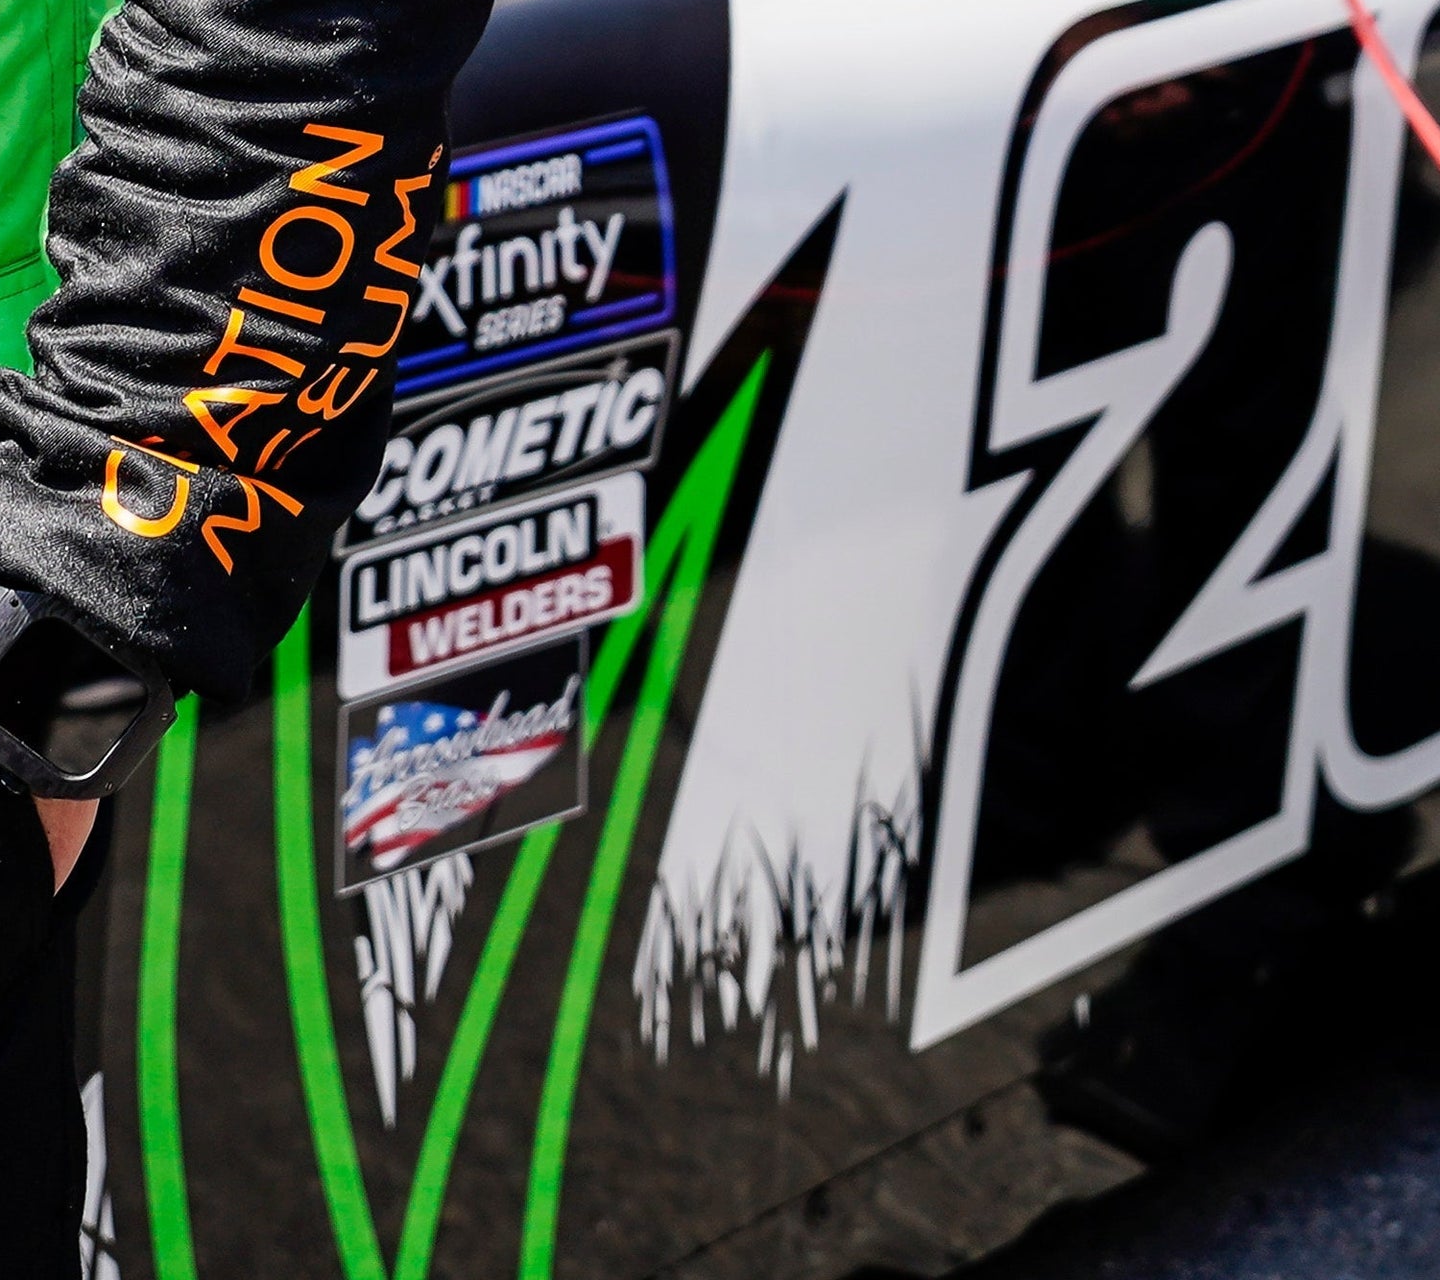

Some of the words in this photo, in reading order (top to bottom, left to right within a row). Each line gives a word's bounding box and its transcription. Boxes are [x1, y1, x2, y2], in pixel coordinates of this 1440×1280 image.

[478, 153, 583, 214] NASCAR
[412, 206, 625, 338] xfinity
[474, 293, 567, 350] SERIES
[356, 367, 666, 522] COMETIC
[358, 502, 592, 624] LINCOLN
[408, 564, 615, 667] WELDERS
